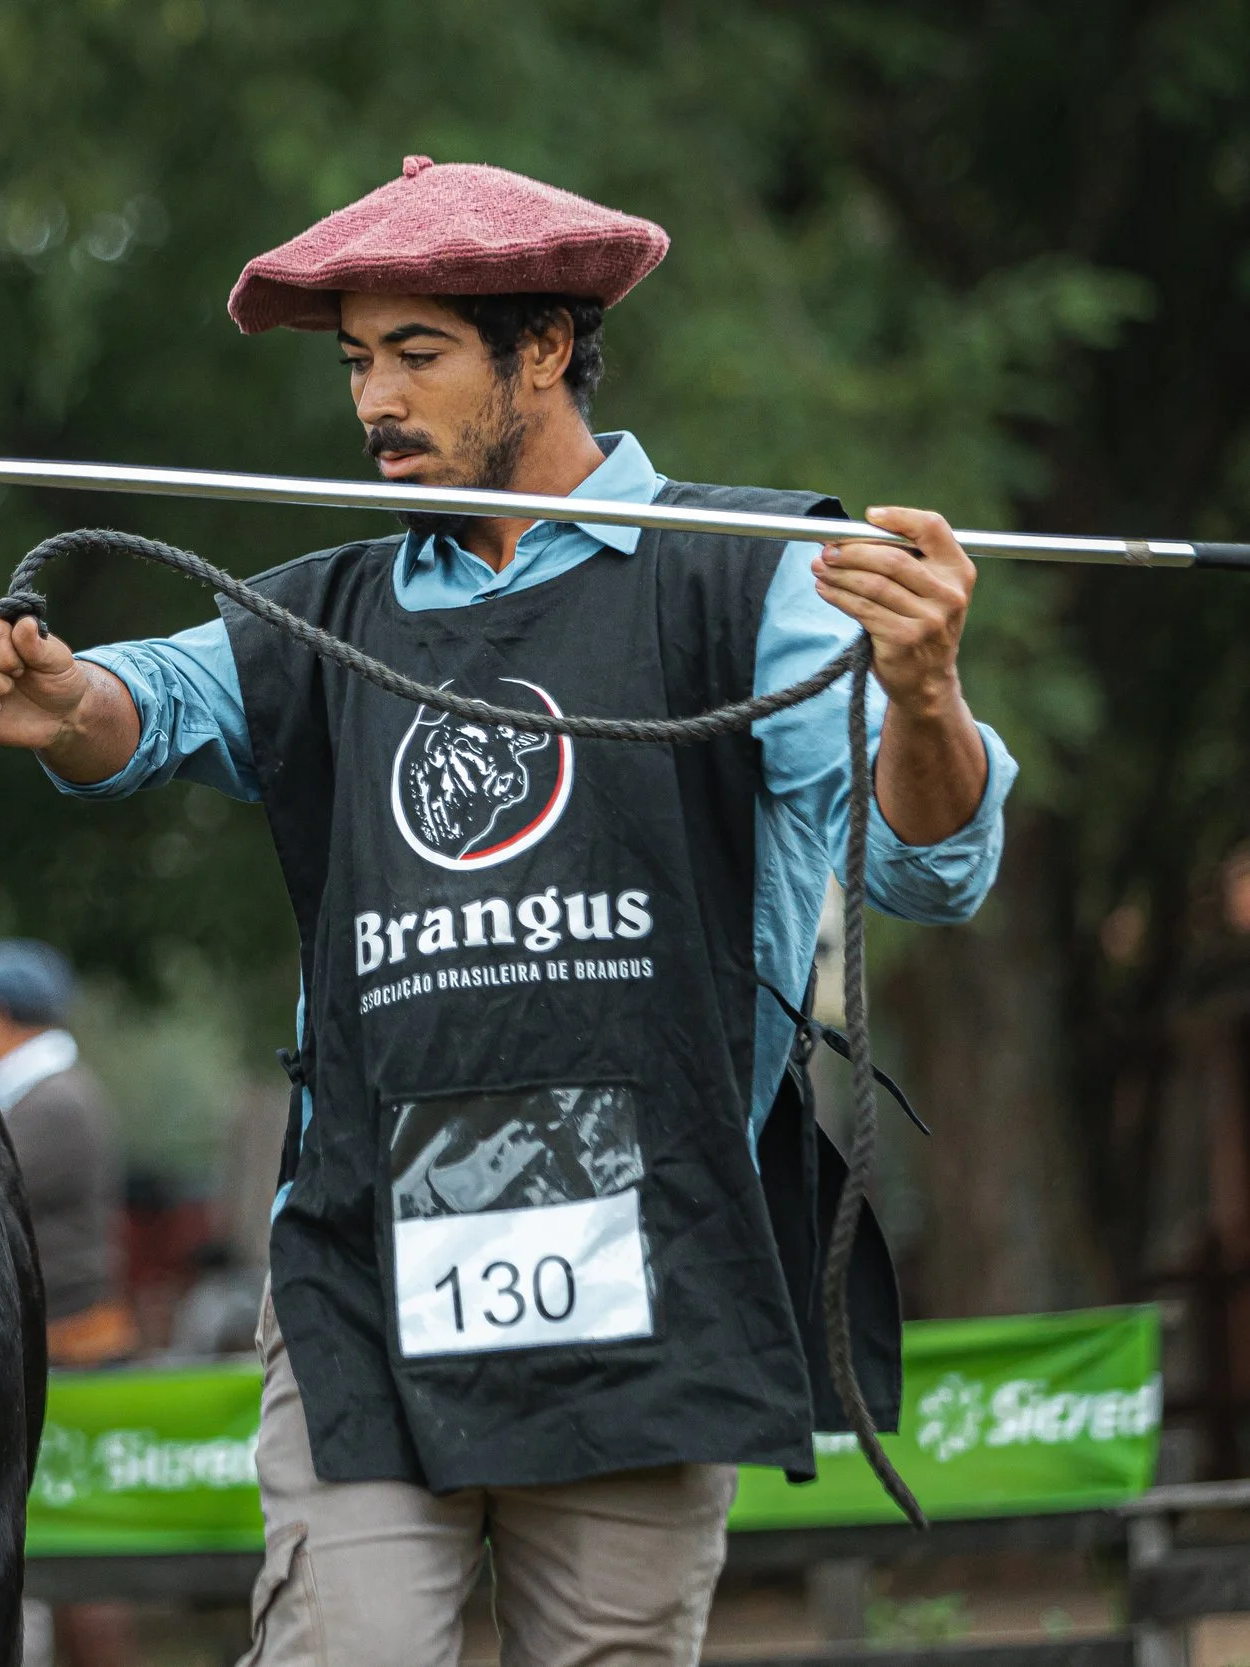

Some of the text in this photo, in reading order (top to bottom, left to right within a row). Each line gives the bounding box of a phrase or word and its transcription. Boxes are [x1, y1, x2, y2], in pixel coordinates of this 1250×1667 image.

[355, 886, 653, 976] Brangus
[360, 958, 653, 1014] SSOCIAÇÃO BRASILEIRA DE BRANGUS
[435, 1255, 576, 1333] 130
